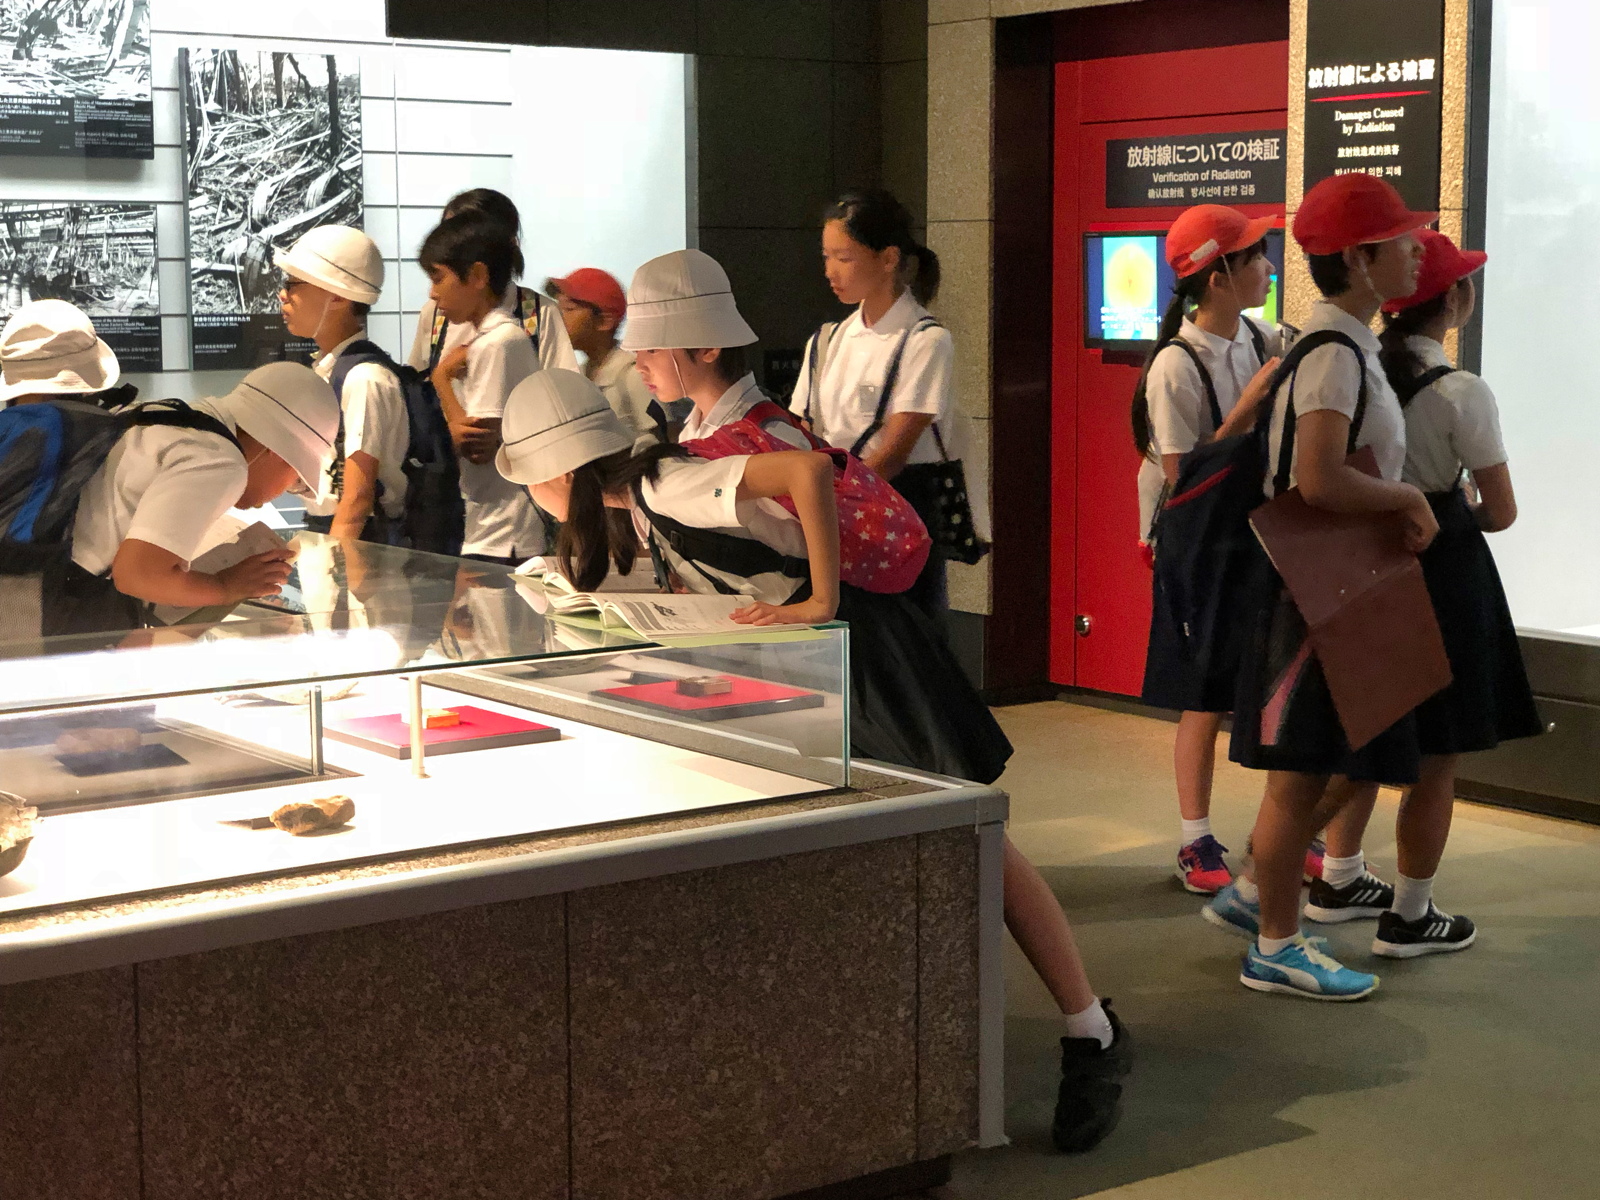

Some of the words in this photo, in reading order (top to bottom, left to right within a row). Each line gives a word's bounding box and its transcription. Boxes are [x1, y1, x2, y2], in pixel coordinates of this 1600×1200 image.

[1308, 59, 1436, 88] 放射線による被害
[1334, 110, 1372, 121] Damages
[1373, 106, 1404, 118] Caused
[1342, 123, 1354, 136] by
[1354, 121, 1396, 133] Radiation
[1127, 138, 1280, 168] 放射線についての検証
[1152, 171, 1199, 183] Verification
[1200, 169, 1210, 181] of
[1211, 168, 1252, 180] Radiation
[1385, 165, 1402, 176] 피해
[1190, 186, 1221, 198] 방사선에
[1222, 185, 1238, 197] 관한
